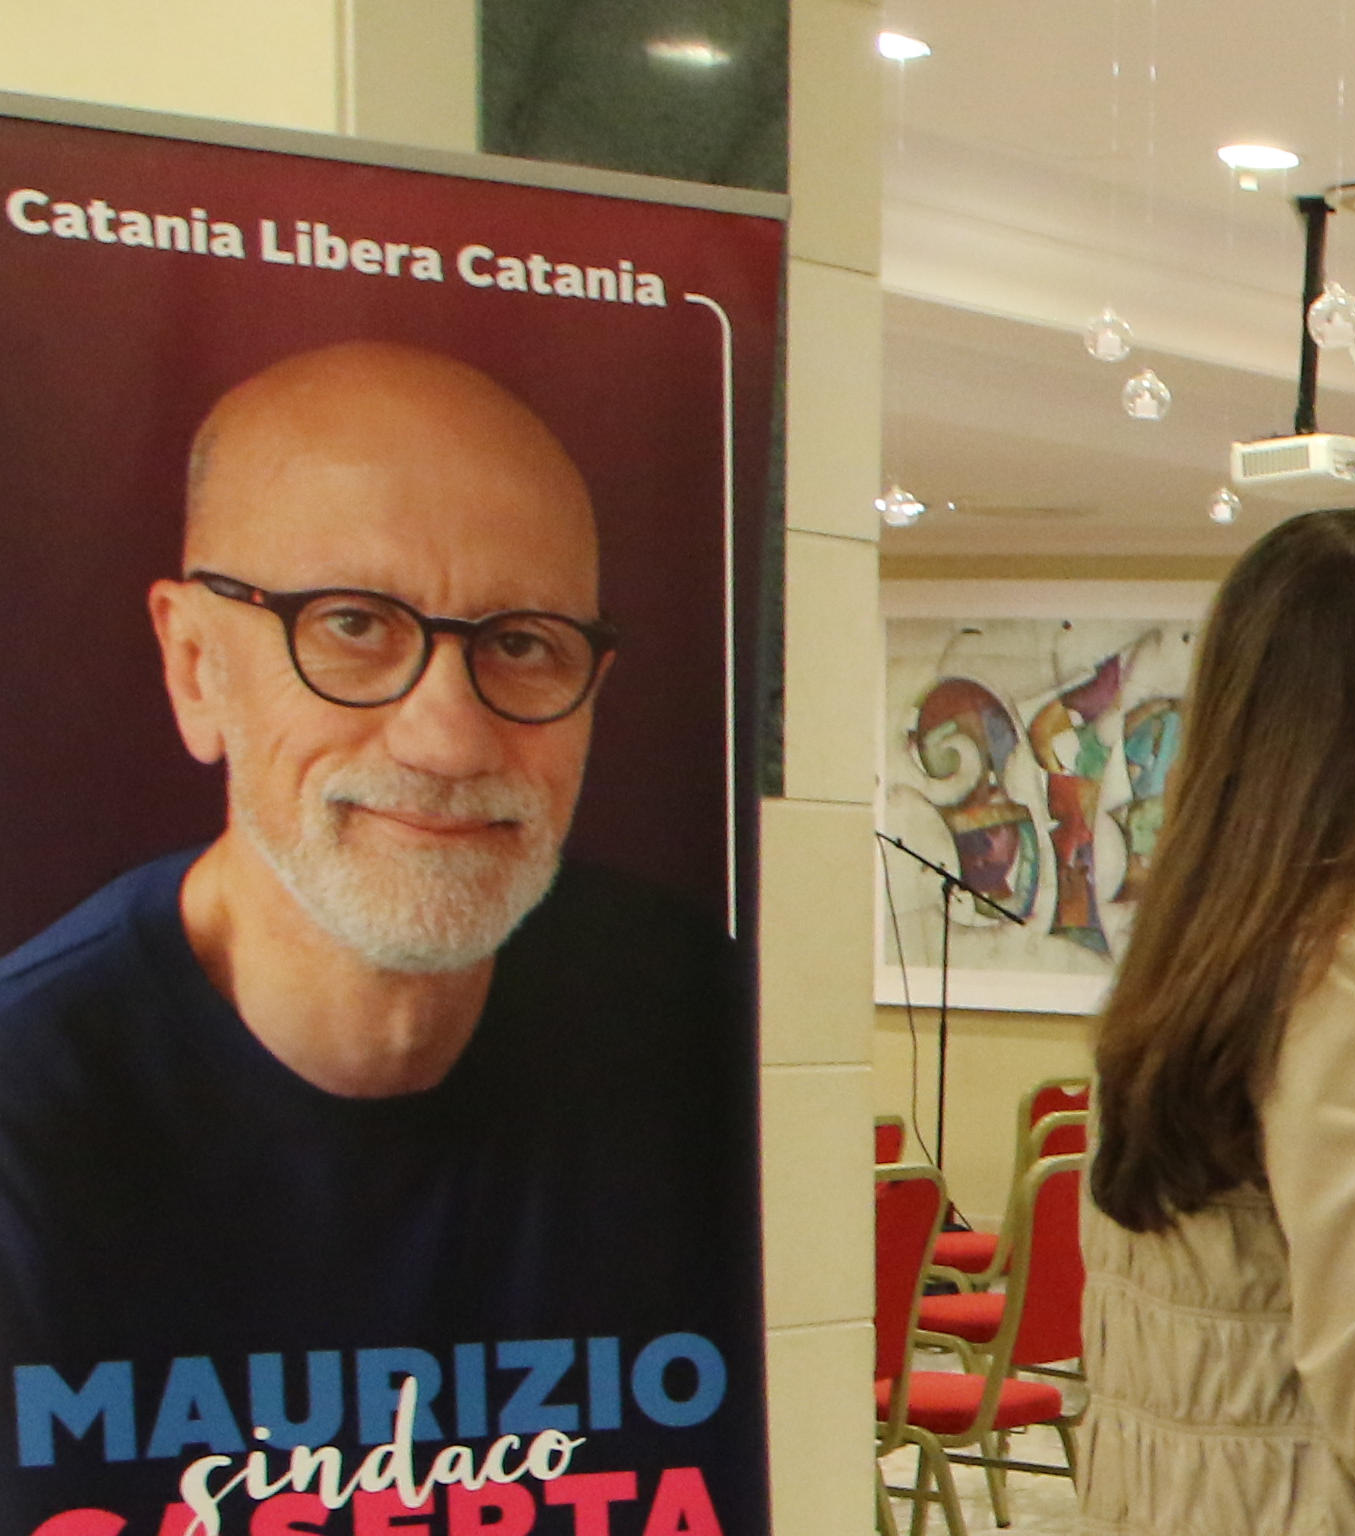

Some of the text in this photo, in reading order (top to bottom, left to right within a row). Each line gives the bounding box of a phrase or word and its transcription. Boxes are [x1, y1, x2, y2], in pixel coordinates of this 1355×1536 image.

[6, 189, 667, 307] Catania Libera Catania
[14, 1332, 728, 1468] MAURIZIO
